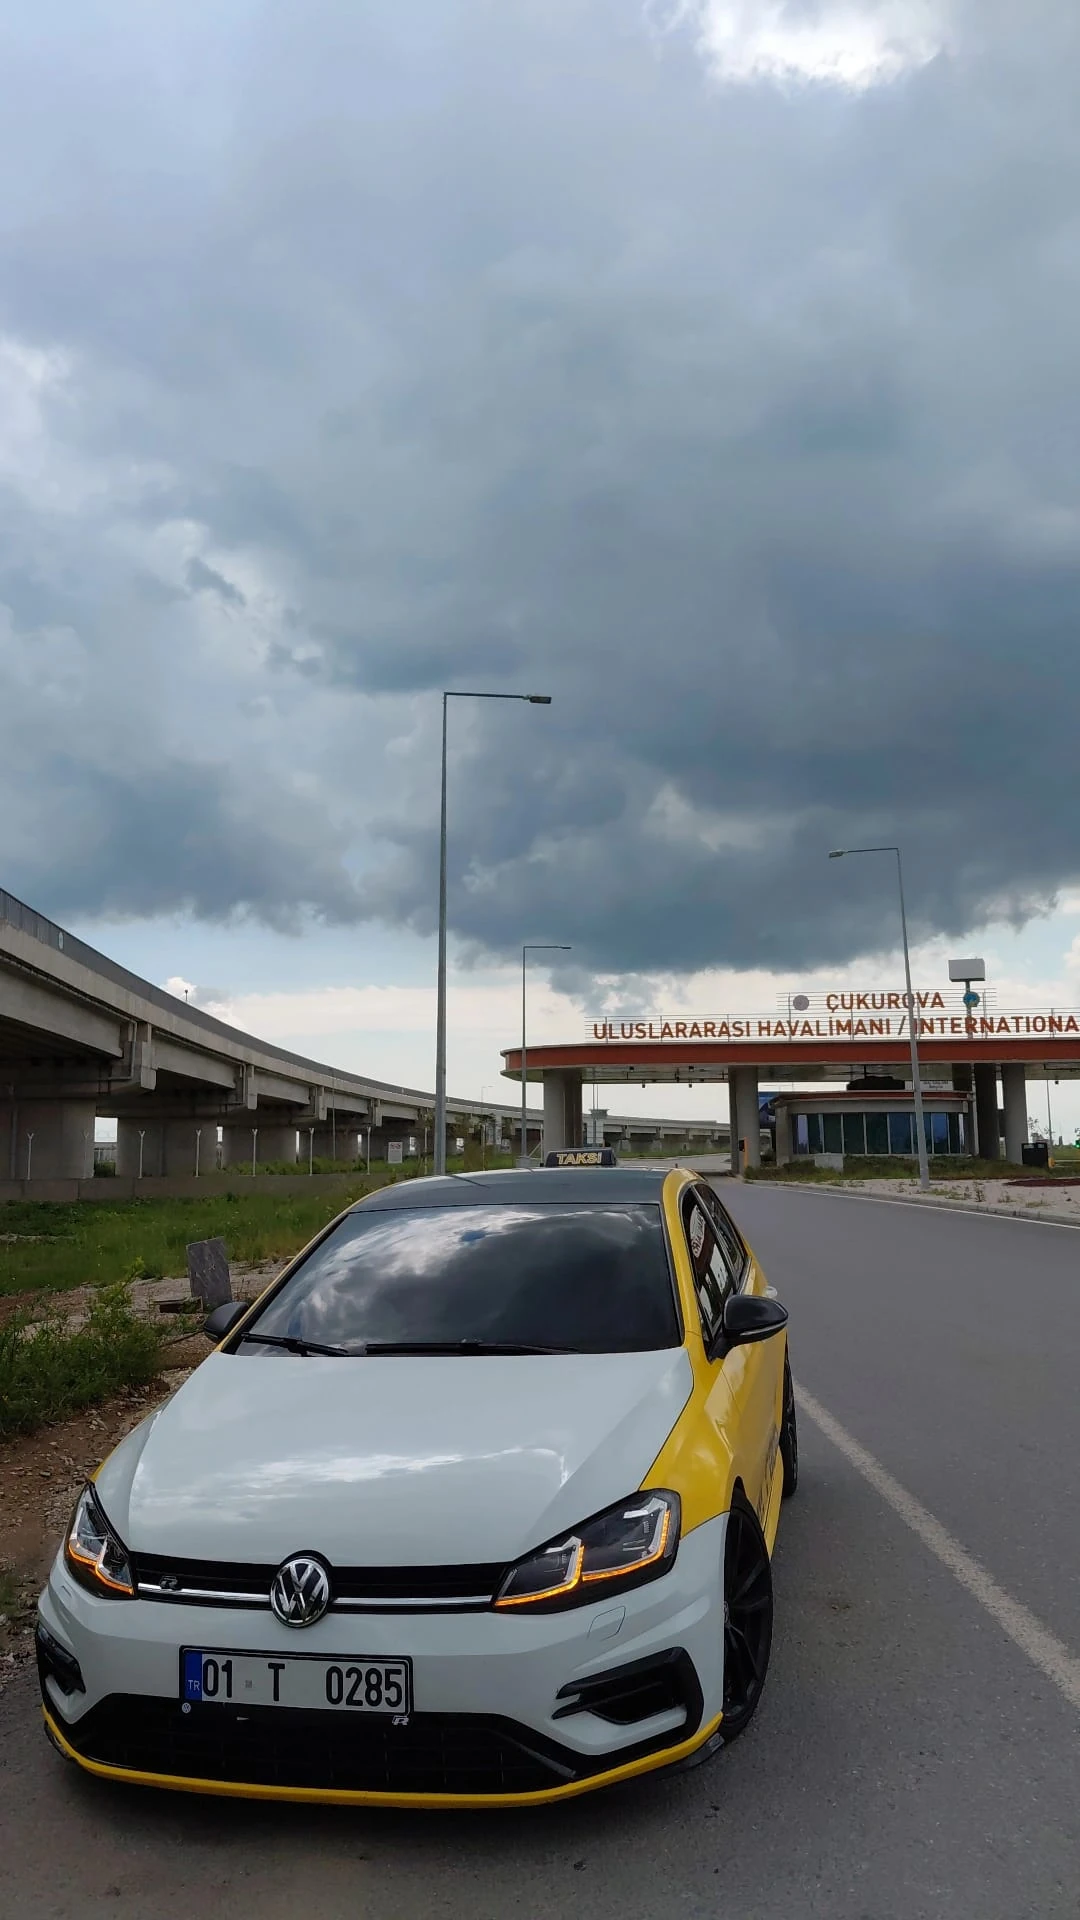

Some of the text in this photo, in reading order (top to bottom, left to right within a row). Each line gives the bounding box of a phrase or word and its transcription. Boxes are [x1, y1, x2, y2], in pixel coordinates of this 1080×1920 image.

[826, 992, 945, 1012] ÇUKUROVA
[593, 1020, 751, 1040] ULUSLARARASI
[758, 1017, 890, 1037] HAVALİMANI
[187, 1679, 201, 1692] TR
[202, 1658, 403, 1708] 01 T 0285
